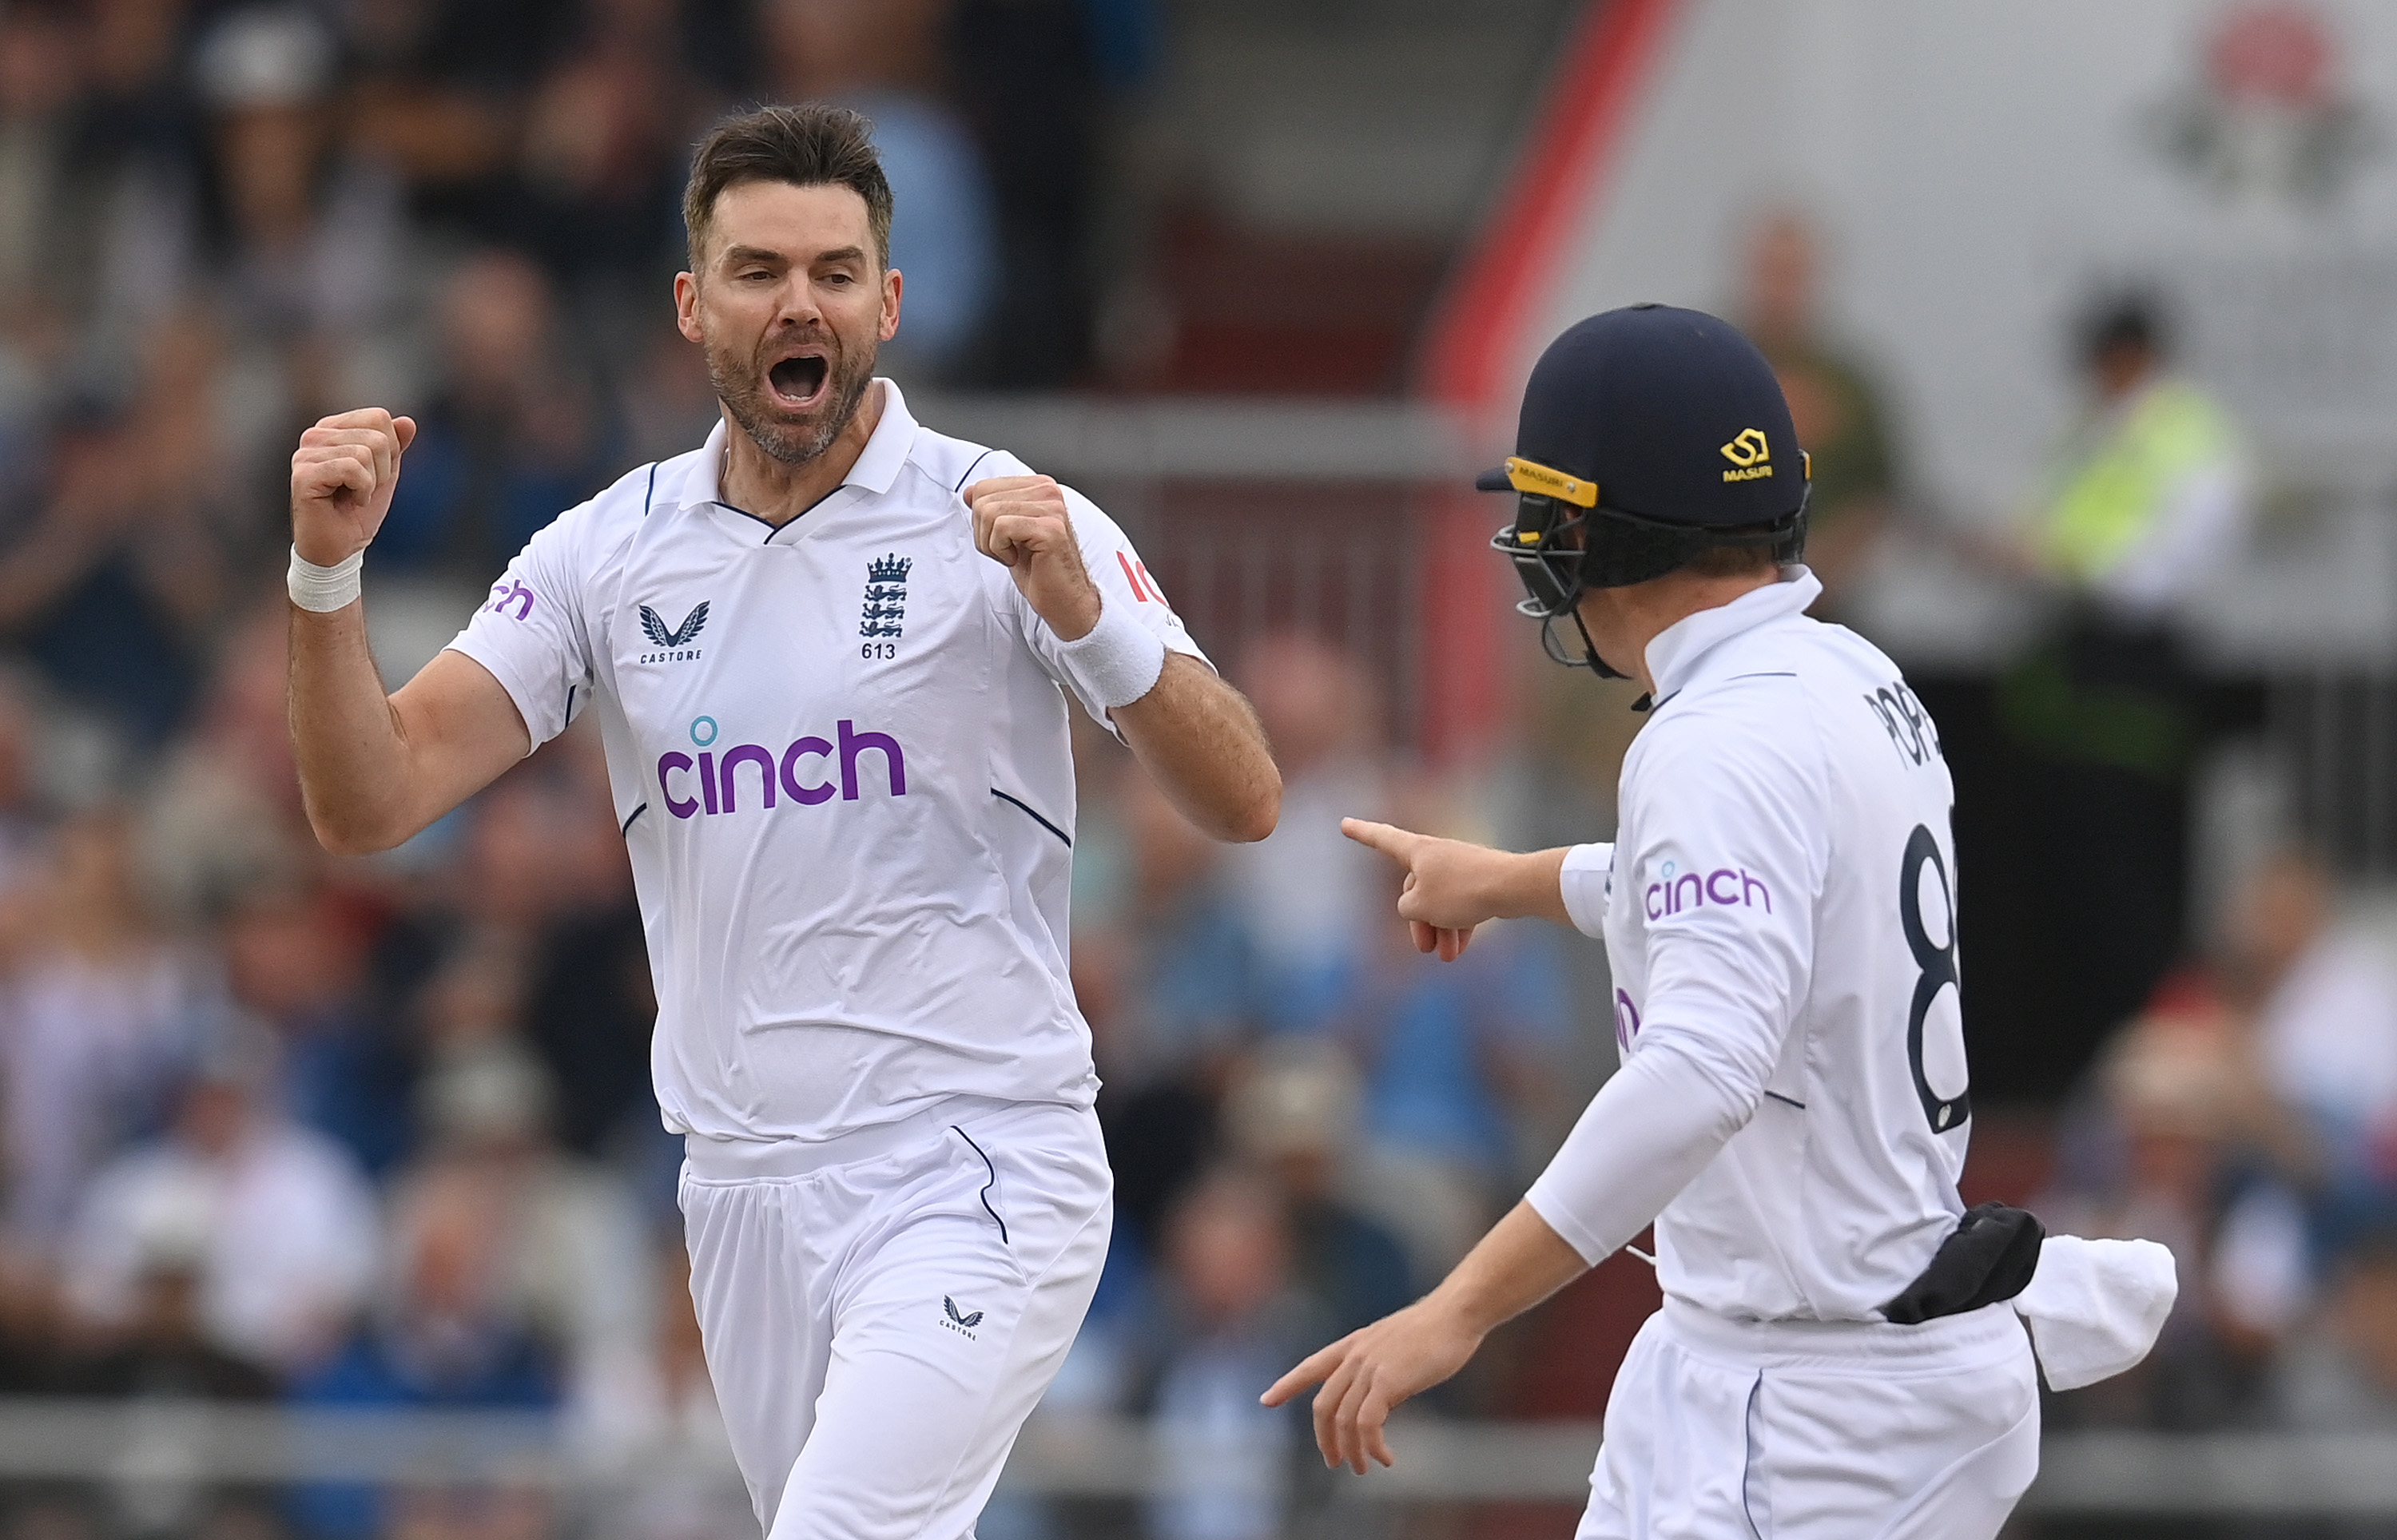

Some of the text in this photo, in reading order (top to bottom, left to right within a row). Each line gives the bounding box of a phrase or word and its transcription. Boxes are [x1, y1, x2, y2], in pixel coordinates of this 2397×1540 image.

[1519, 466, 1564, 486] MASURI
[1723, 465, 1773, 482] MASURI
[641, 650, 702, 663] CASTORE
[861, 643, 896, 660] 613
[658, 716, 906, 819] cinch
[1646, 860, 1771, 921] cinch
[1899, 803, 1970, 1135] 8
[939, 1320, 976, 1341] CASTORE
